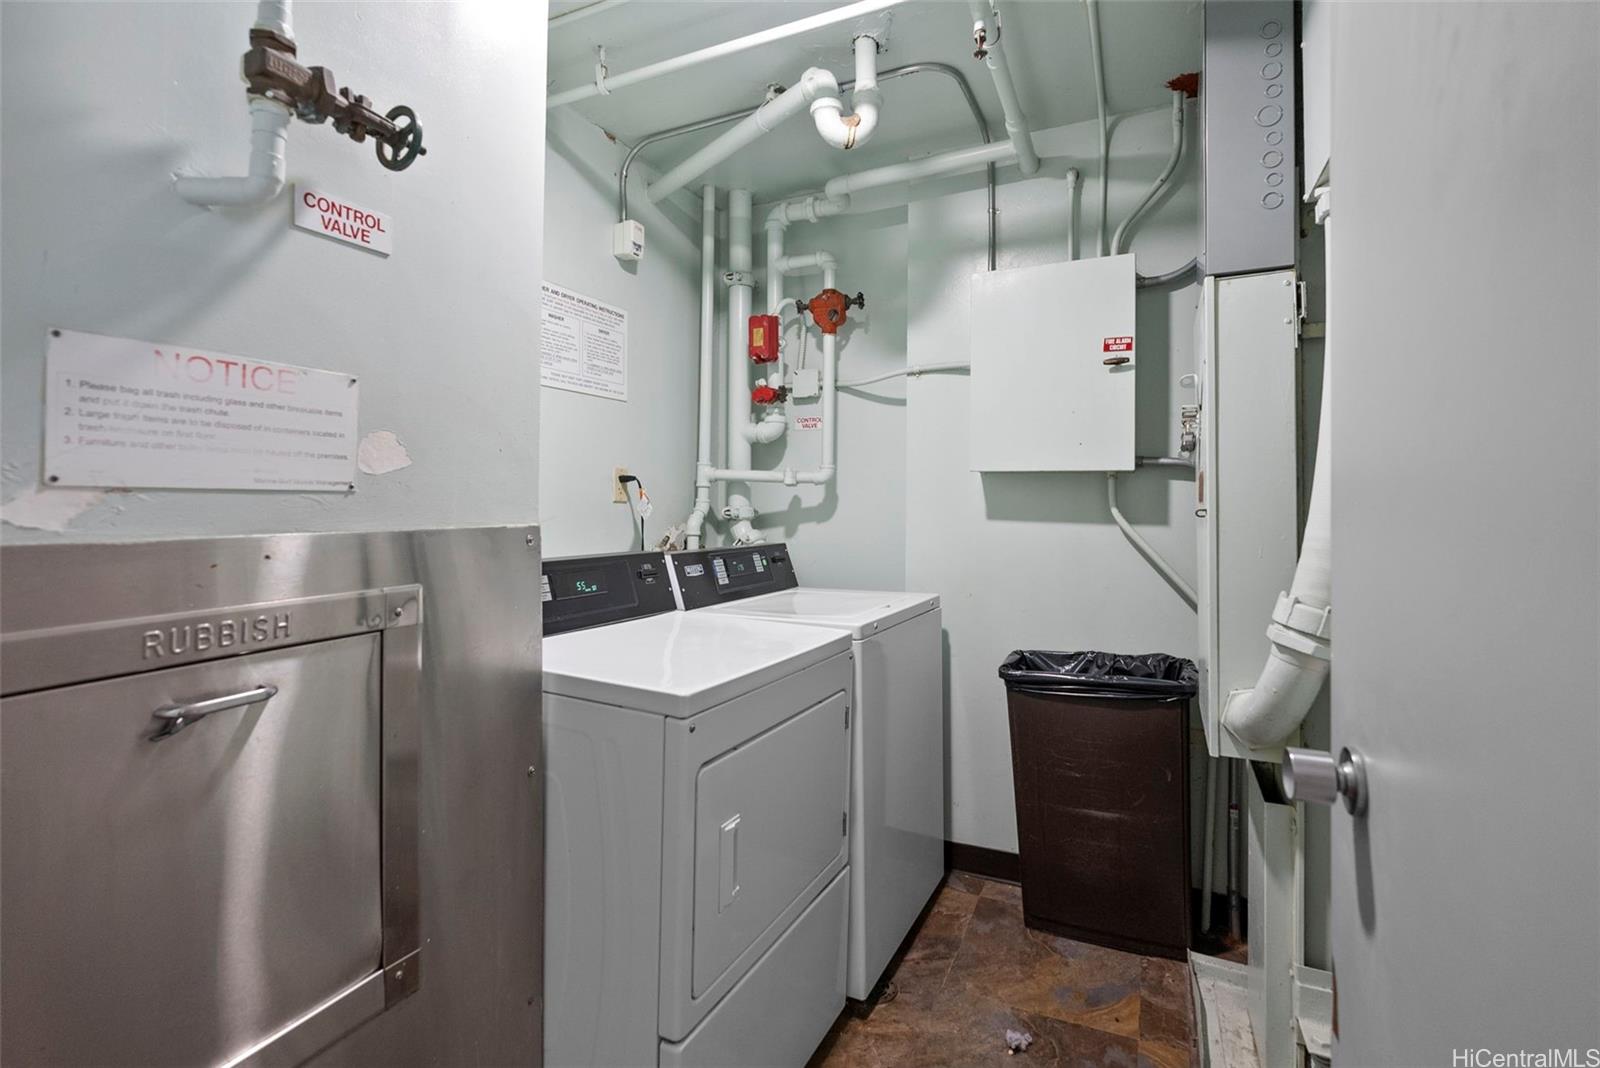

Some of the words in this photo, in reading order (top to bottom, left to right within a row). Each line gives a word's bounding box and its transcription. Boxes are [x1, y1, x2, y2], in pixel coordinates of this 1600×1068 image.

[304, 192, 386, 233] CONTROL
[320, 214, 371, 245] VALVE
[548, 313, 565, 322] WASHER
[550, 288, 560, 297] AND
[561, 292, 575, 302] DRYER
[576, 297, 598, 310] OPERATING
[598, 306, 625, 319] INSTRUCTIONS
[153, 348, 296, 395] NOTICE
[65, 378, 76, 389] 1.
[79, 379, 117, 392] Please
[119, 385, 140, 397] bag
[142, 388, 154, 397] all
[156, 389, 180, 399] trash
[183, 392, 222, 405] including
[224, 398, 247, 407] glass
[248, 401, 264, 409] and
[265, 402, 286, 410] other
[324, 408, 343, 418] items
[79, 395, 100, 405] and
[103, 398, 120, 408] put
[161, 402, 176, 411] the
[178, 404, 202, 414] trash
[64, 406, 75, 417] 2.
[79, 408, 110, 421] Large
[142, 414, 168, 425] items
[171, 417, 186, 426] are
[188, 418, 198, 427] to
[200, 419, 212, 428] be
[214, 420, 252, 432] disposed
[253, 424, 263, 432] of
[263, 425, 271, 433] in
[272, 426, 310, 436] containers
[312, 429, 337, 439] located
[64, 434, 74, 446] 3.
[78, 435, 127, 448] Furniture
[129, 440, 150, 449] and
[151, 441, 176, 451] other
[304, 450, 316, 459] the
[317, 451, 349, 462] premises.
[142, 612, 292, 659] RUBBISH
